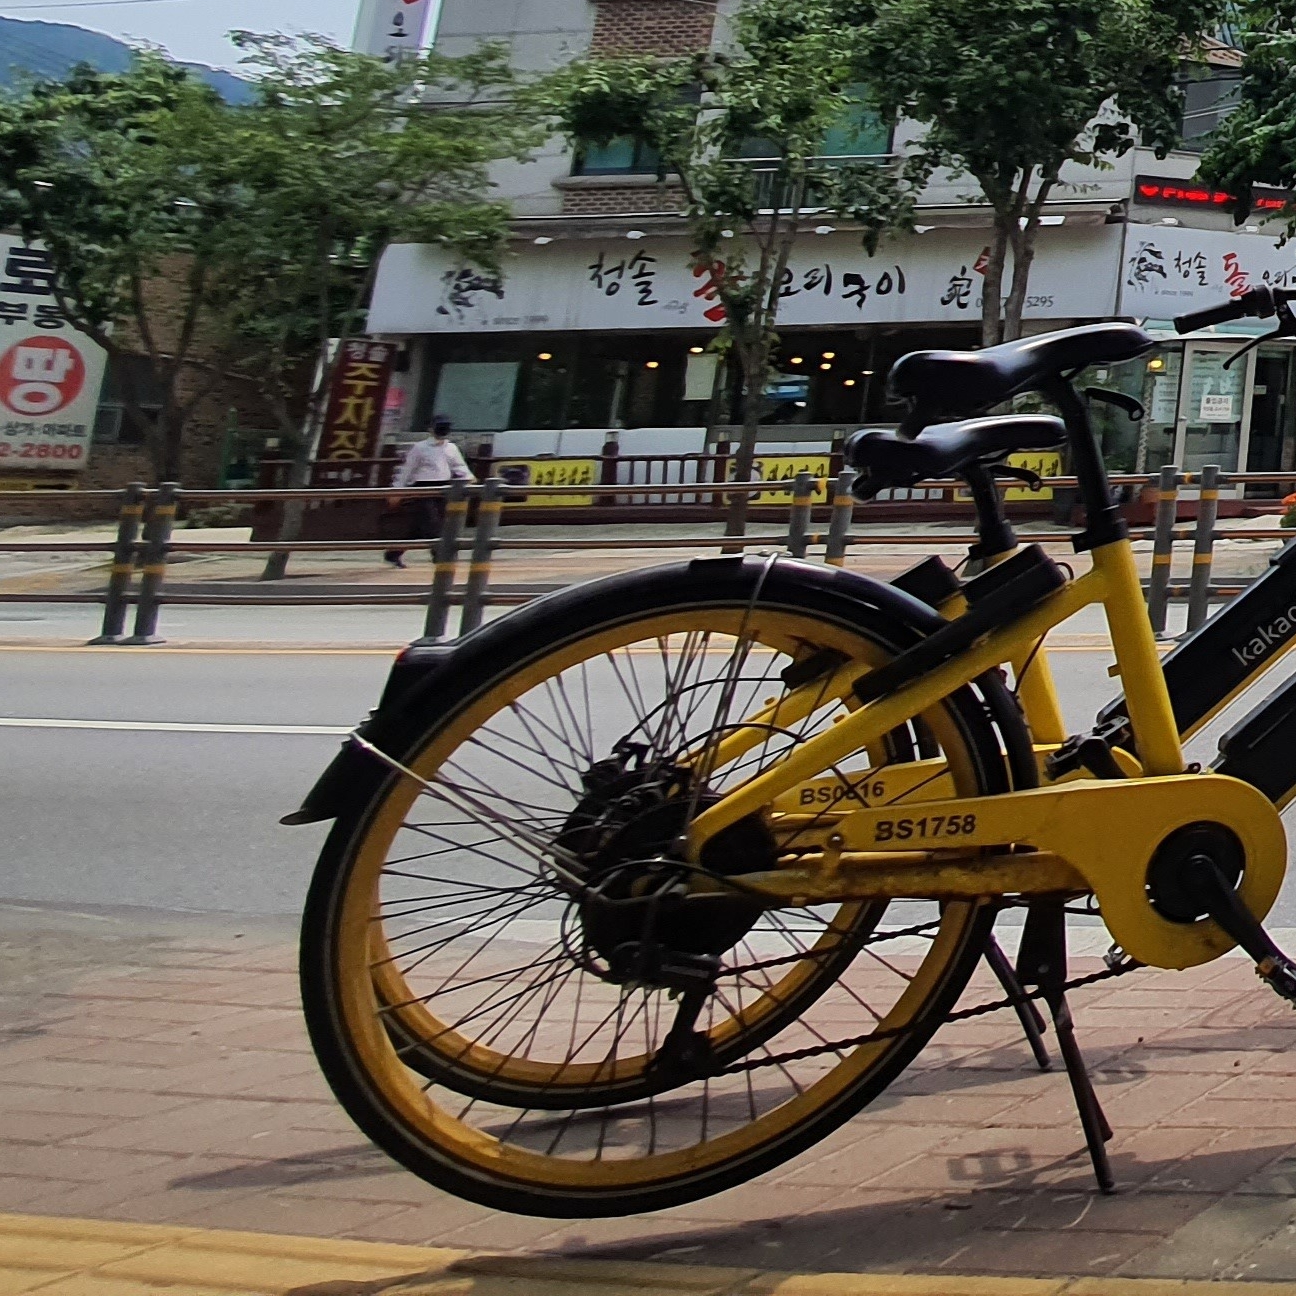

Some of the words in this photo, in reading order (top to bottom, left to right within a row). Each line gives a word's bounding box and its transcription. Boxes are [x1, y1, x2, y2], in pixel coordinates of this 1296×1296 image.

[588, 249, 658, 305] 청솔
[1174, 251, 1209, 285] 청솔
[1223, 253, 1249, 297] 돌
[9, 345, 76, 406] 땅
[328, 362, 384, 461] 주차장
[875, 813, 977, 842] BS1758
